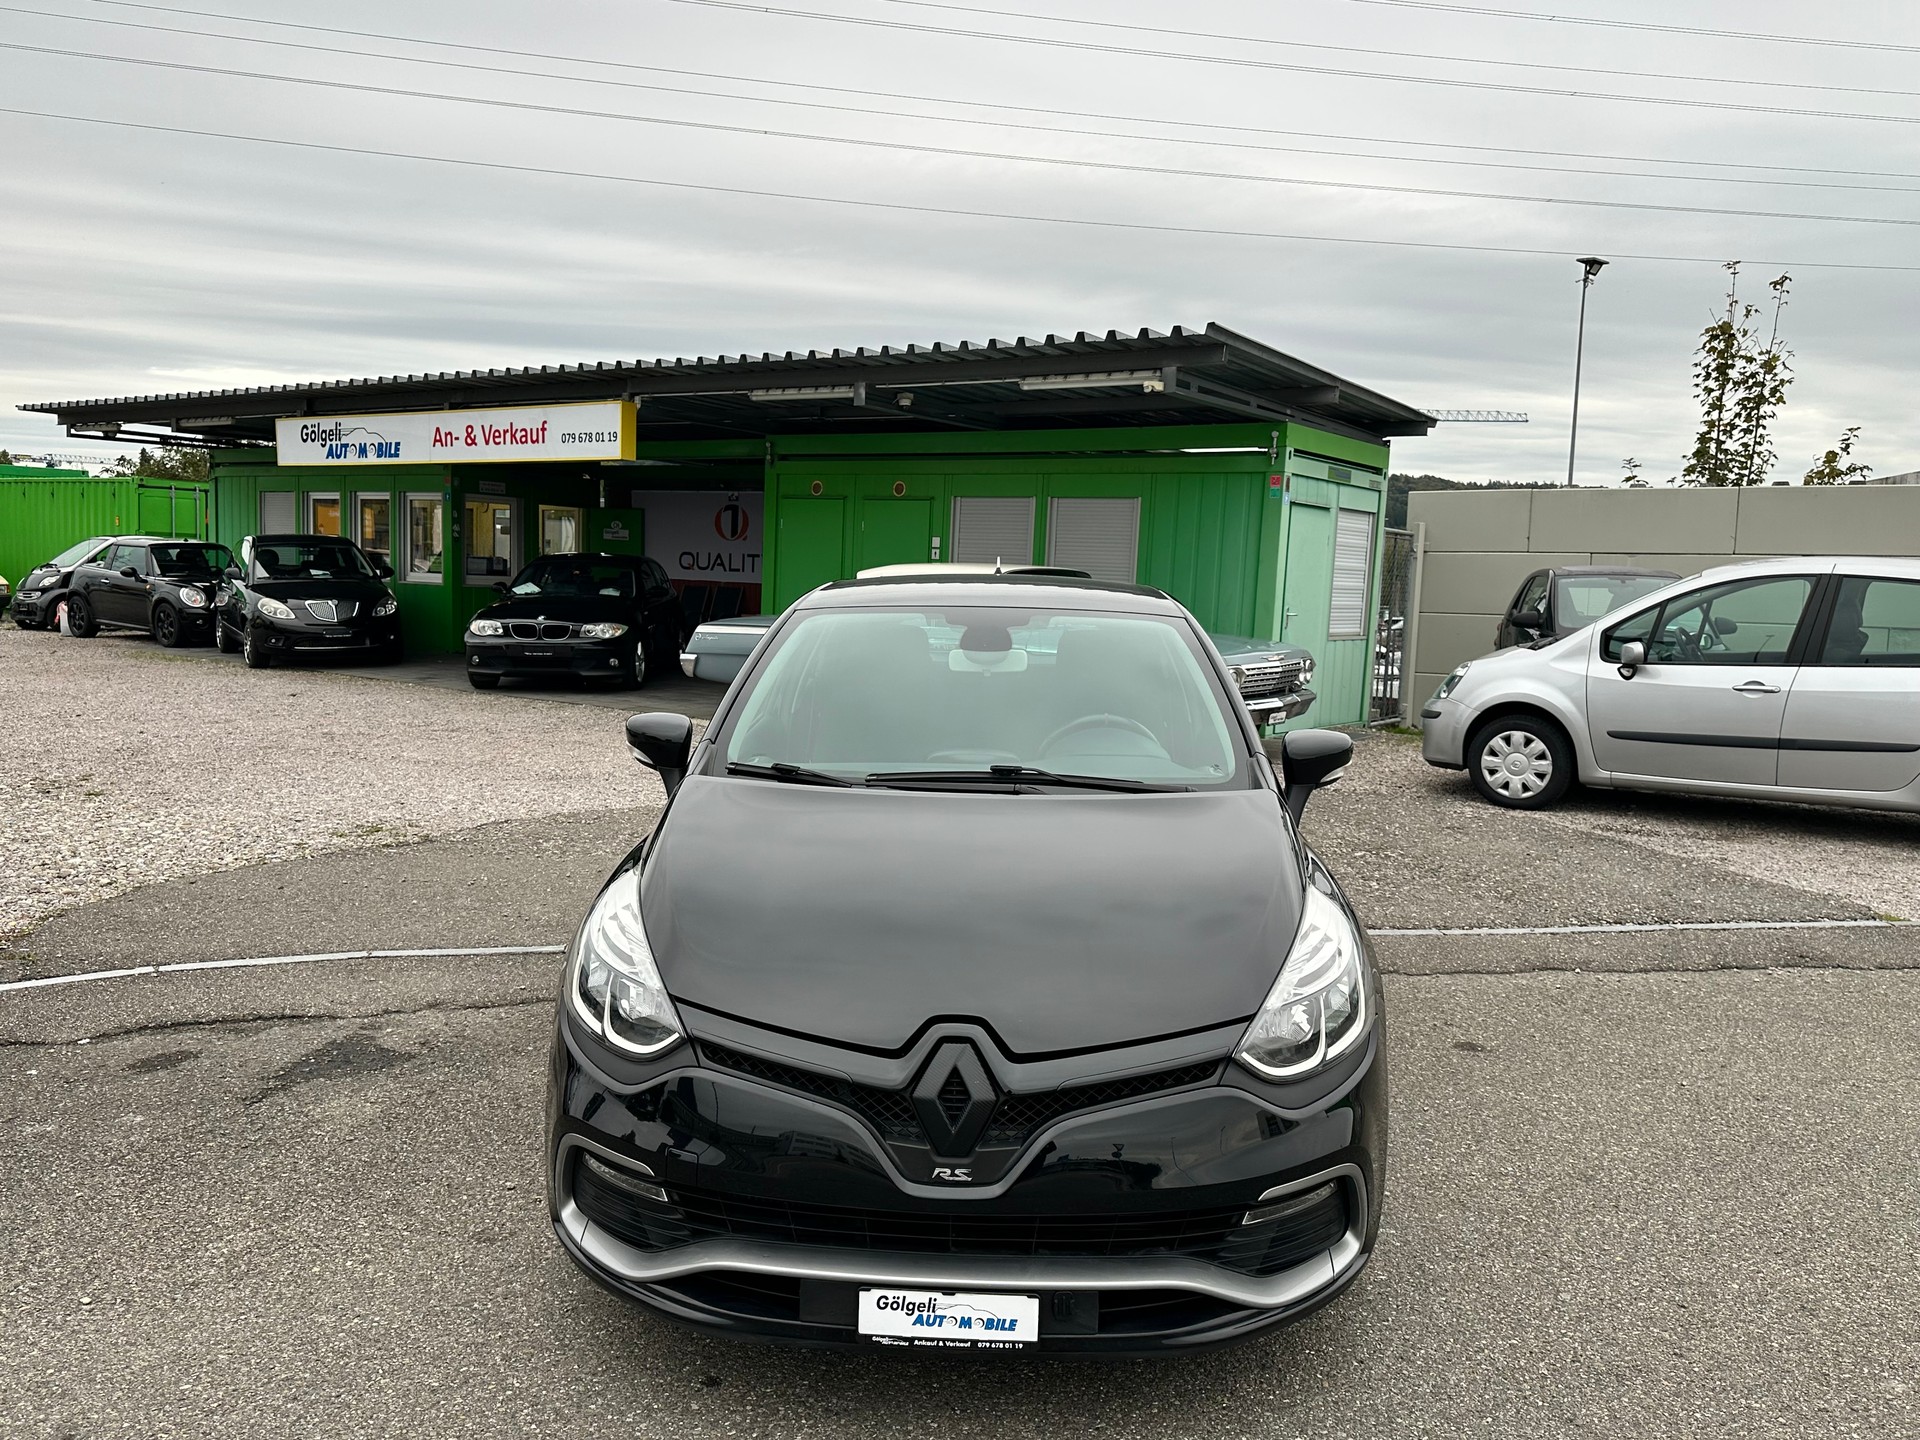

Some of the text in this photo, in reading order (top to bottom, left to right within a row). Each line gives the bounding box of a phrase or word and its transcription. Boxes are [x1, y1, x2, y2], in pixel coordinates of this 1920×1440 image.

[301, 422, 341, 448] Gölgeli
[432, 420, 548, 447] An- & Verkauf
[561, 431, 618, 444] 079 678 01 19
[679, 551, 764, 573] QUALIT
[931, 1167, 973, 1182] RS
[876, 1295, 938, 1317] Gölgeli
